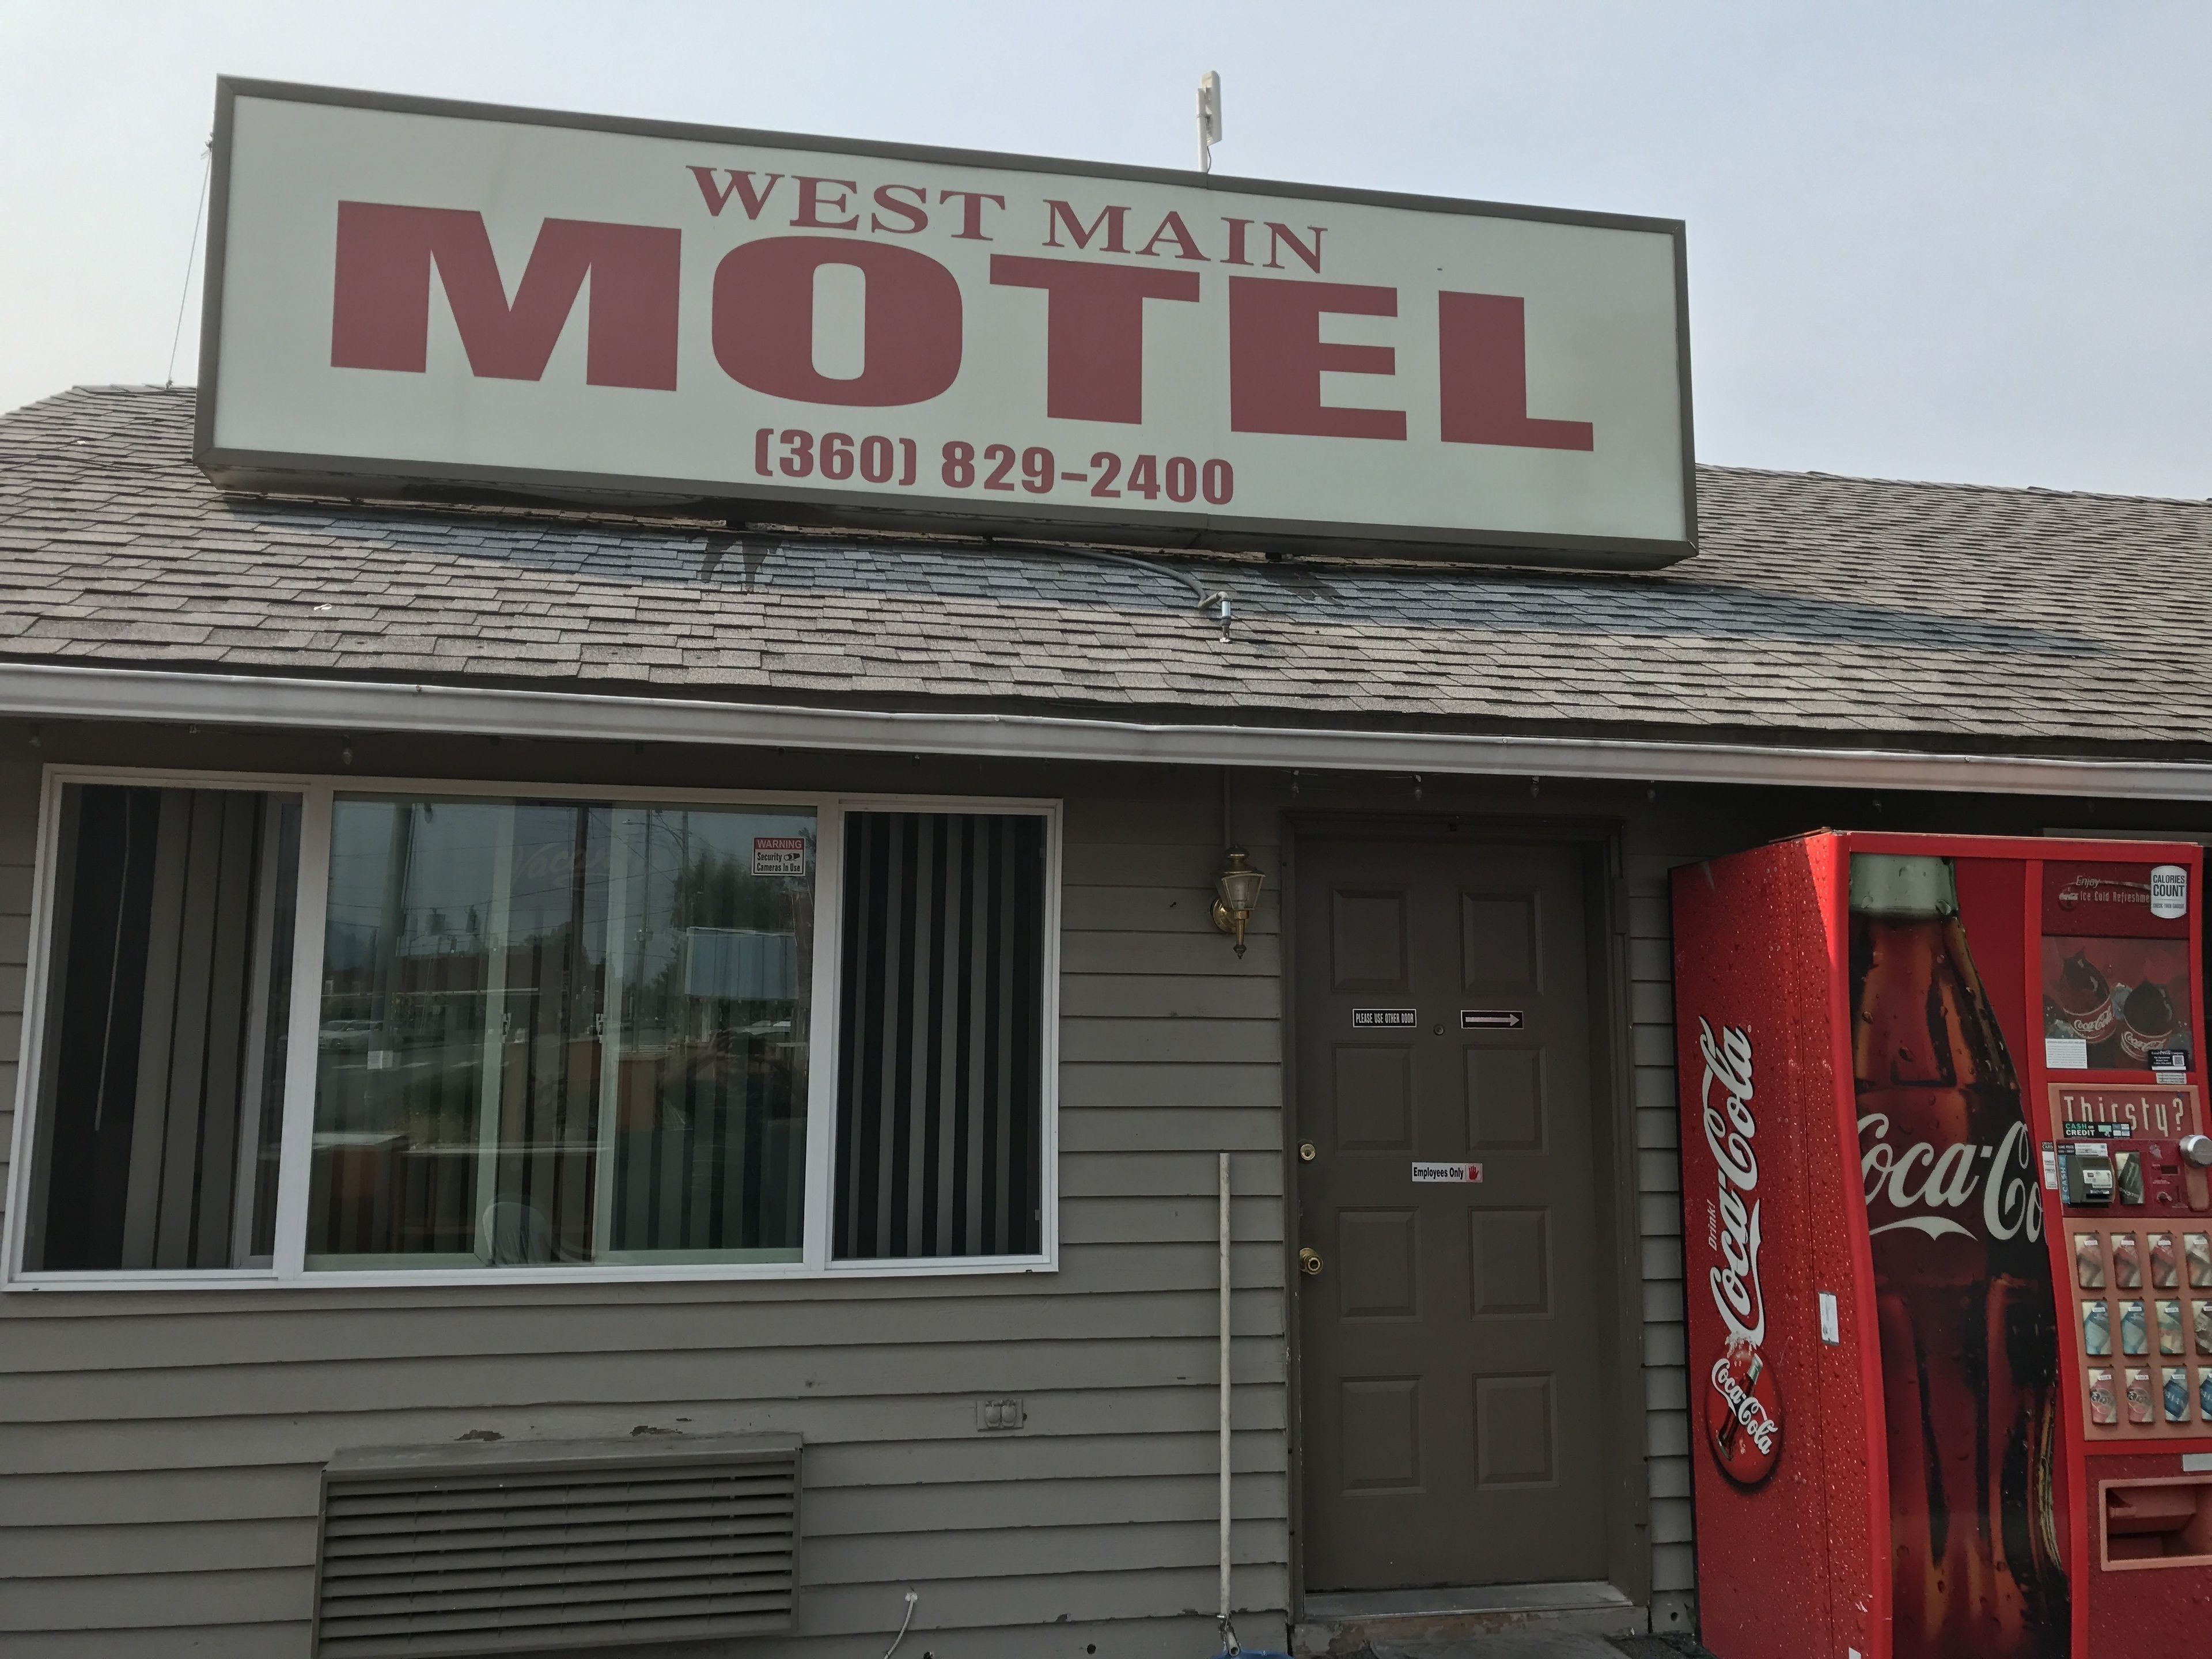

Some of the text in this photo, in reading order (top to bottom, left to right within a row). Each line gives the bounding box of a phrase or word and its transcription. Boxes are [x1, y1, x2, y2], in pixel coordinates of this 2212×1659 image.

[686, 165, 1328, 274] WEST MAIN
[331, 200, 1594, 452] MOTEL
[755, 427, 1234, 505] (360) 829-2400
[757, 839, 802, 849] WARNING
[756, 863, 801, 872] Cameras In Use
[757, 852, 782, 863] Security
[2075, 875, 2100, 889] Enjoy
[2153, 874, 2185, 884] CALORIES
[2080, 891, 2091, 902] Ice
[2094, 891, 2109, 902] Cold
[2112, 891, 2150, 904] Refreshme
[2153, 884, 2184, 897] COUNT
[1355, 1013, 1414, 1024] PLEASE USE OTHER DOOR
[2074, 1004, 2113, 1032] Coca-Cola
[2063, 1096, 2184, 1138] Thirsty?
[1413, 1166, 1464, 1180] Employees Only
[1698, 1015, 1765, 1347] Coca-Cola
[2061, 1166, 2069, 1193] CASH
[1707, 1199, 1718, 1252] Drink!
[1711, 1358, 1778, 1455] Coca-Cola
